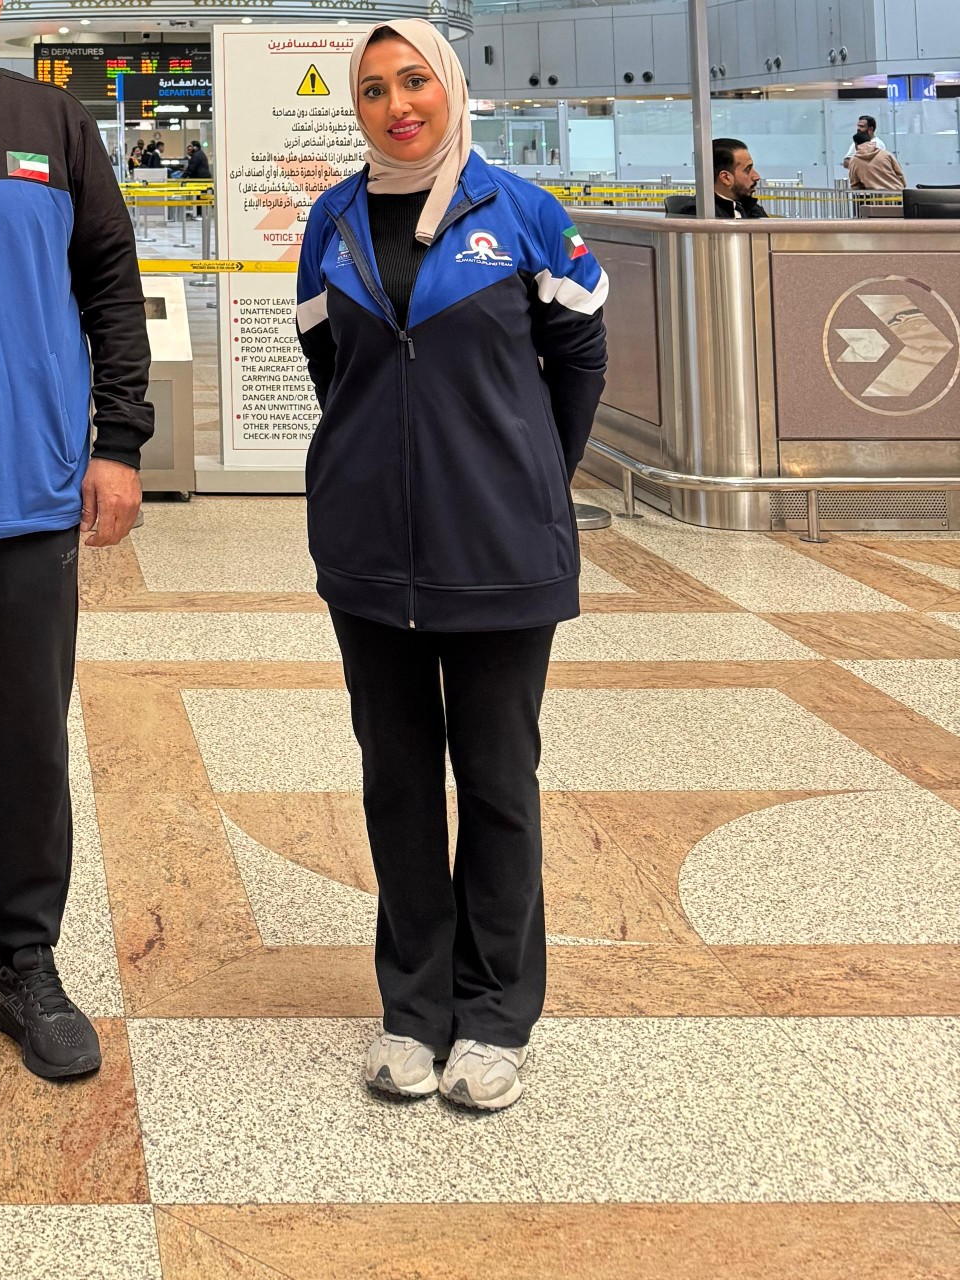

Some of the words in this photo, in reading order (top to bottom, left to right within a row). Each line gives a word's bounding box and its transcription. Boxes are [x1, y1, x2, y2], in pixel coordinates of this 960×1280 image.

[268, 39, 327, 51] للمسافرين
[329, 38, 354, 51] تنبيه
[51, 48, 105, 56] DEPARTURES
[159, 79, 197, 87] المغادرة
[272, 107, 296, 119] مصاحبة
[297, 109, 307, 118] دون
[329, 122, 347, 133] خطيرة
[264, 233, 293, 241] NOTICE
